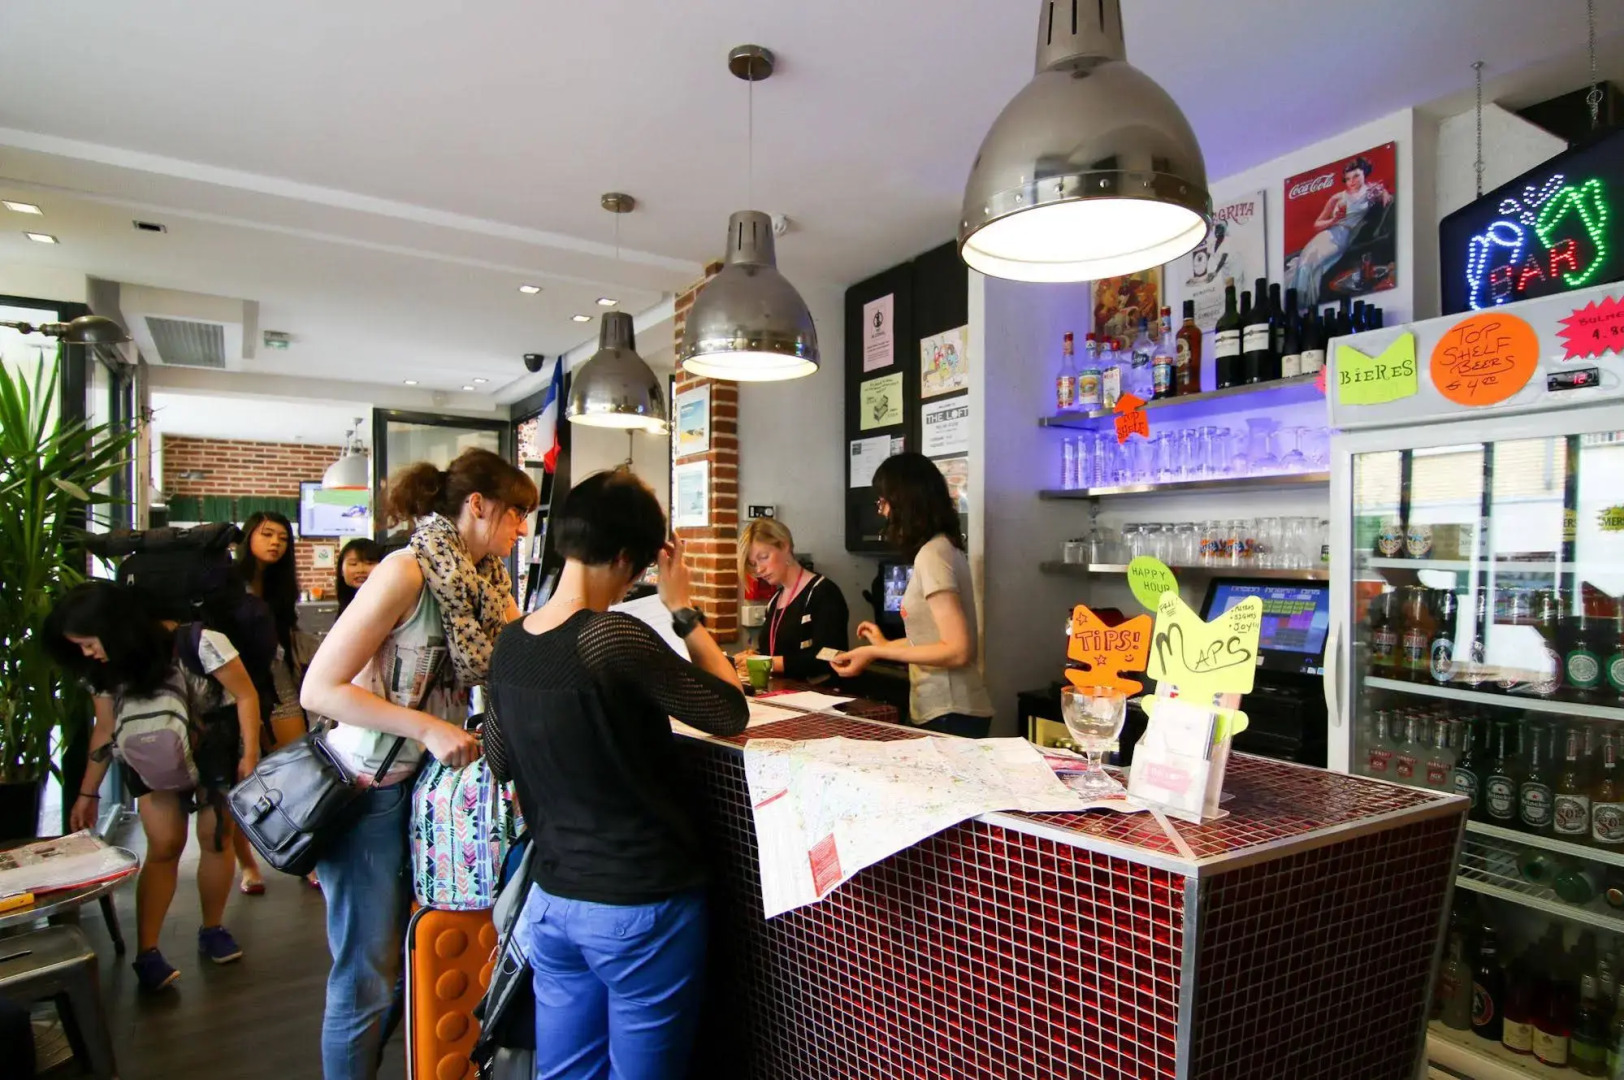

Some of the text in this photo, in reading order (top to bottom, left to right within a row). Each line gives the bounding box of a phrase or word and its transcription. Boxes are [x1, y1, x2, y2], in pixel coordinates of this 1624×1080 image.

[1490, 238, 1577, 300] BAR
[1452, 322, 1502, 346] TOP
[1440, 337, 1512, 366] SHELF
[1450, 355, 1516, 376] BEERS
[926, 413, 943, 425] THE
[946, 407, 969, 422] LOFT
[1131, 566, 1167, 581] HAPPY
[1143, 582, 1171, 594] HOUR
